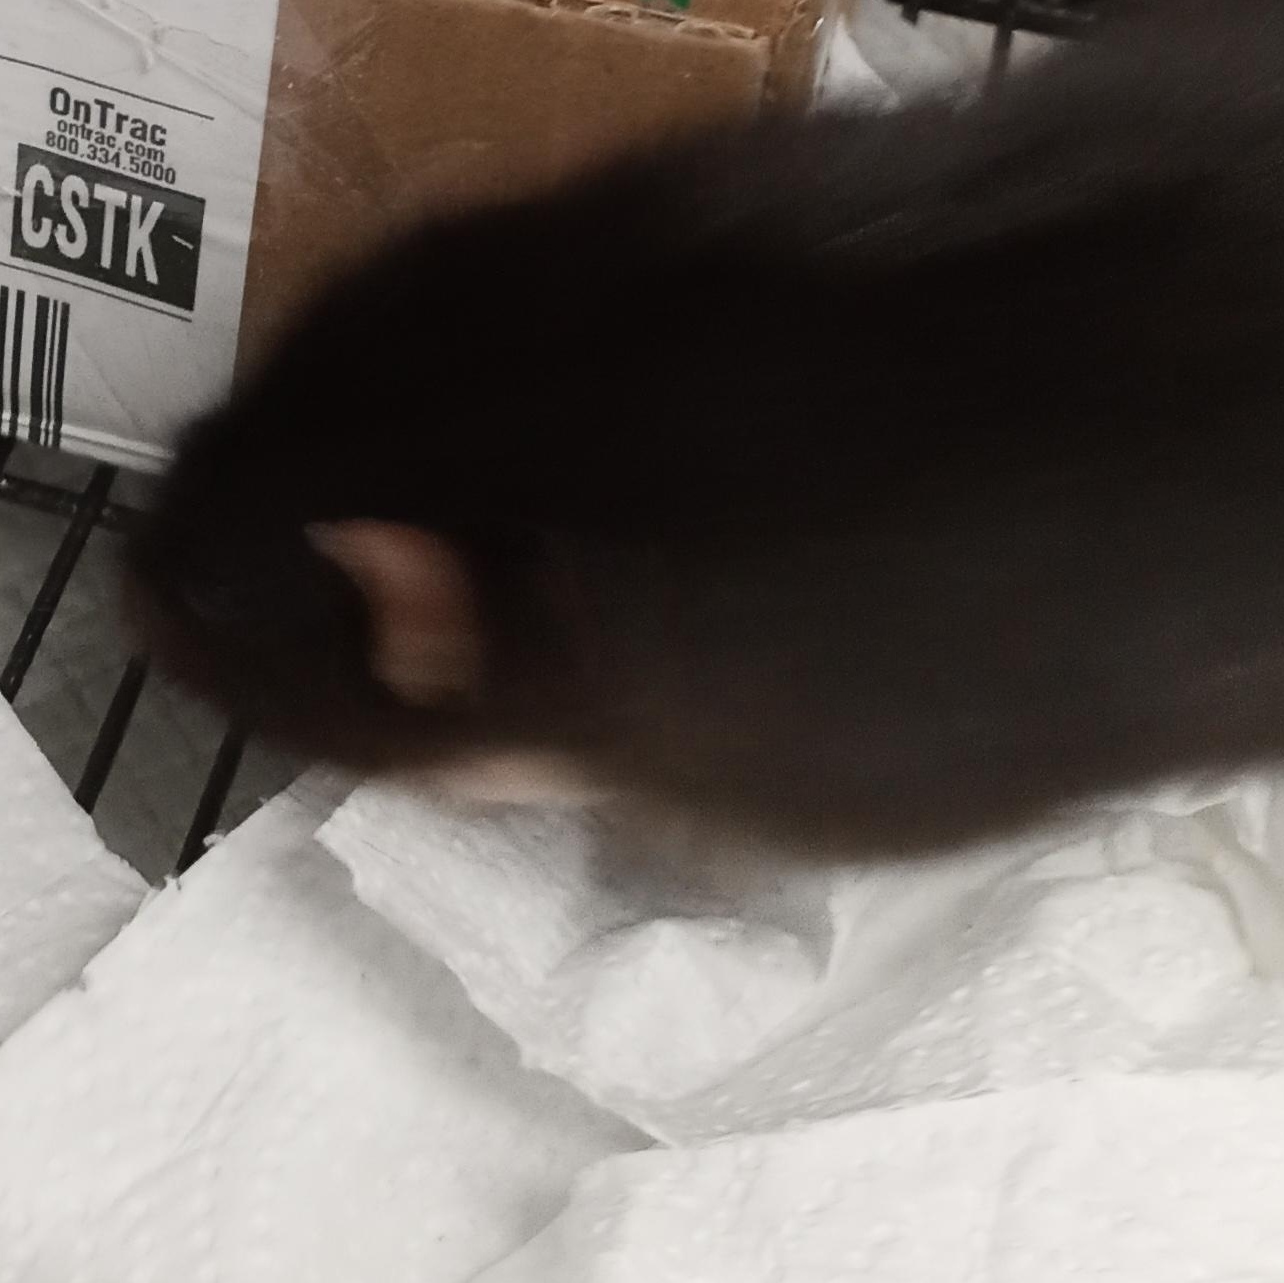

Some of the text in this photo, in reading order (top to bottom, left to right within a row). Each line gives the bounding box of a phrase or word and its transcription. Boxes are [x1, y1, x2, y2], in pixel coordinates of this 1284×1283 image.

[49, 86, 168, 148] OnTrac
[56, 119, 166, 163] ontrac.com
[44, 129, 177, 186] 800.334.5000
[20, 162, 166, 287] CSTK
